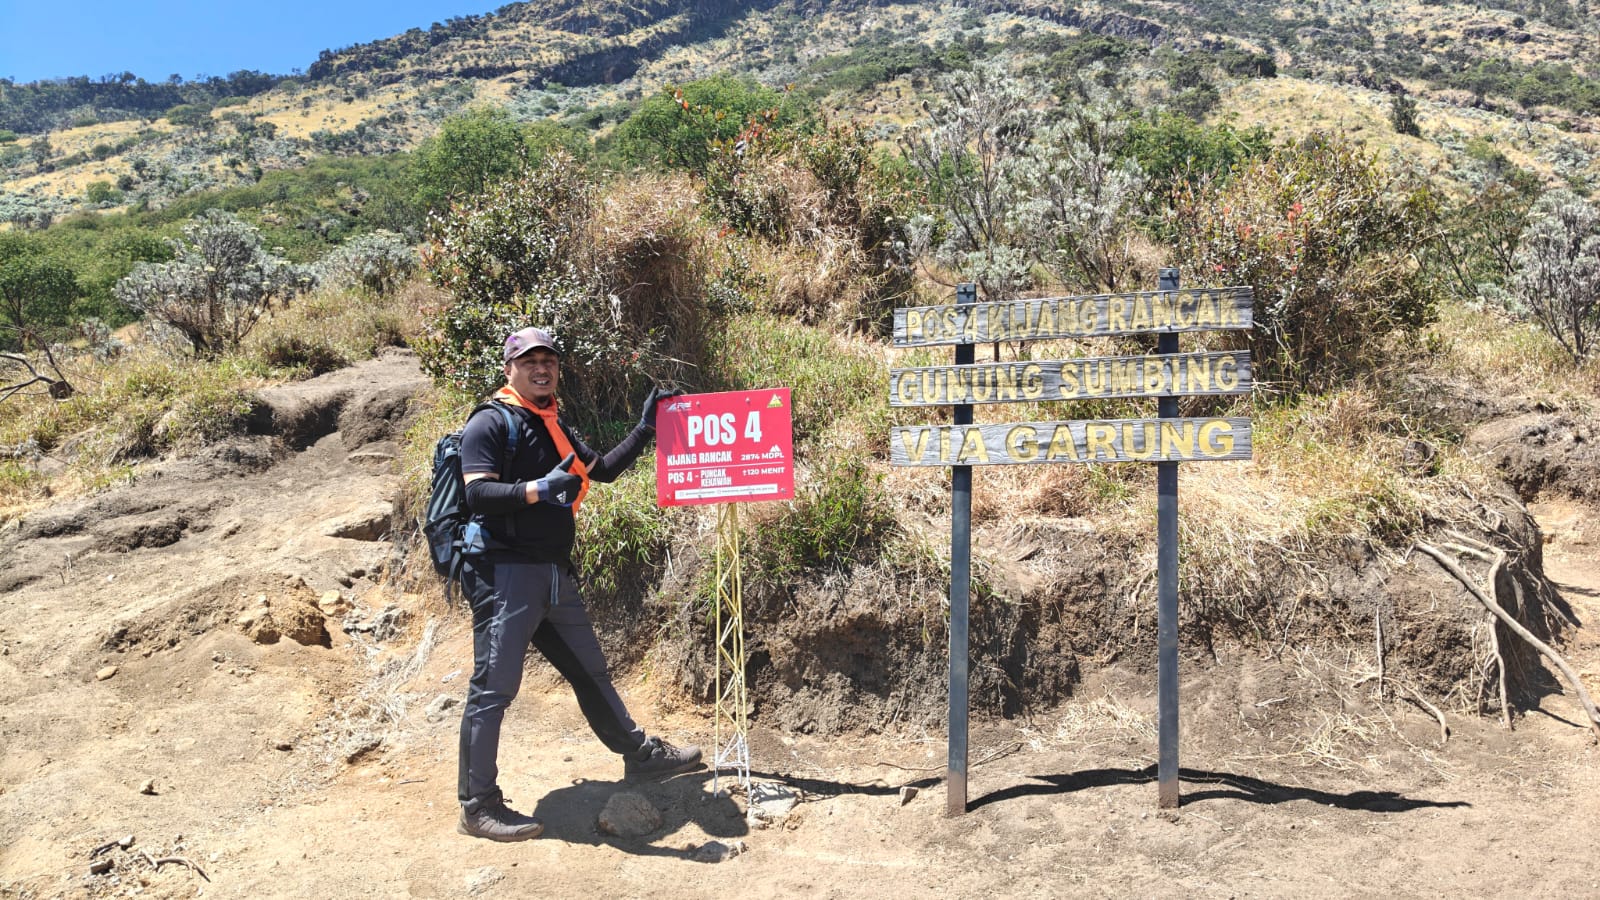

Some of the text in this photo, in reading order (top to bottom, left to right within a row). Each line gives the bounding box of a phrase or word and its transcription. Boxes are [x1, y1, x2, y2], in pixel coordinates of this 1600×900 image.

[907, 292, 1240, 343] POS 4 KIJANG RANCAK
[897, 355, 1239, 405] GUNUNG SUMBING
[687, 411, 762, 448] POS 4
[899, 420, 1235, 466] VIA GARUNG
[667, 451, 732, 466] KIJANG RANCAK
[761, 452, 784, 460] MDPL
[668, 472, 684, 485] POS
[686, 471, 693, 483] 4
[700, 468, 727, 479] PUNCAK
[761, 467, 785, 475] MENIT
